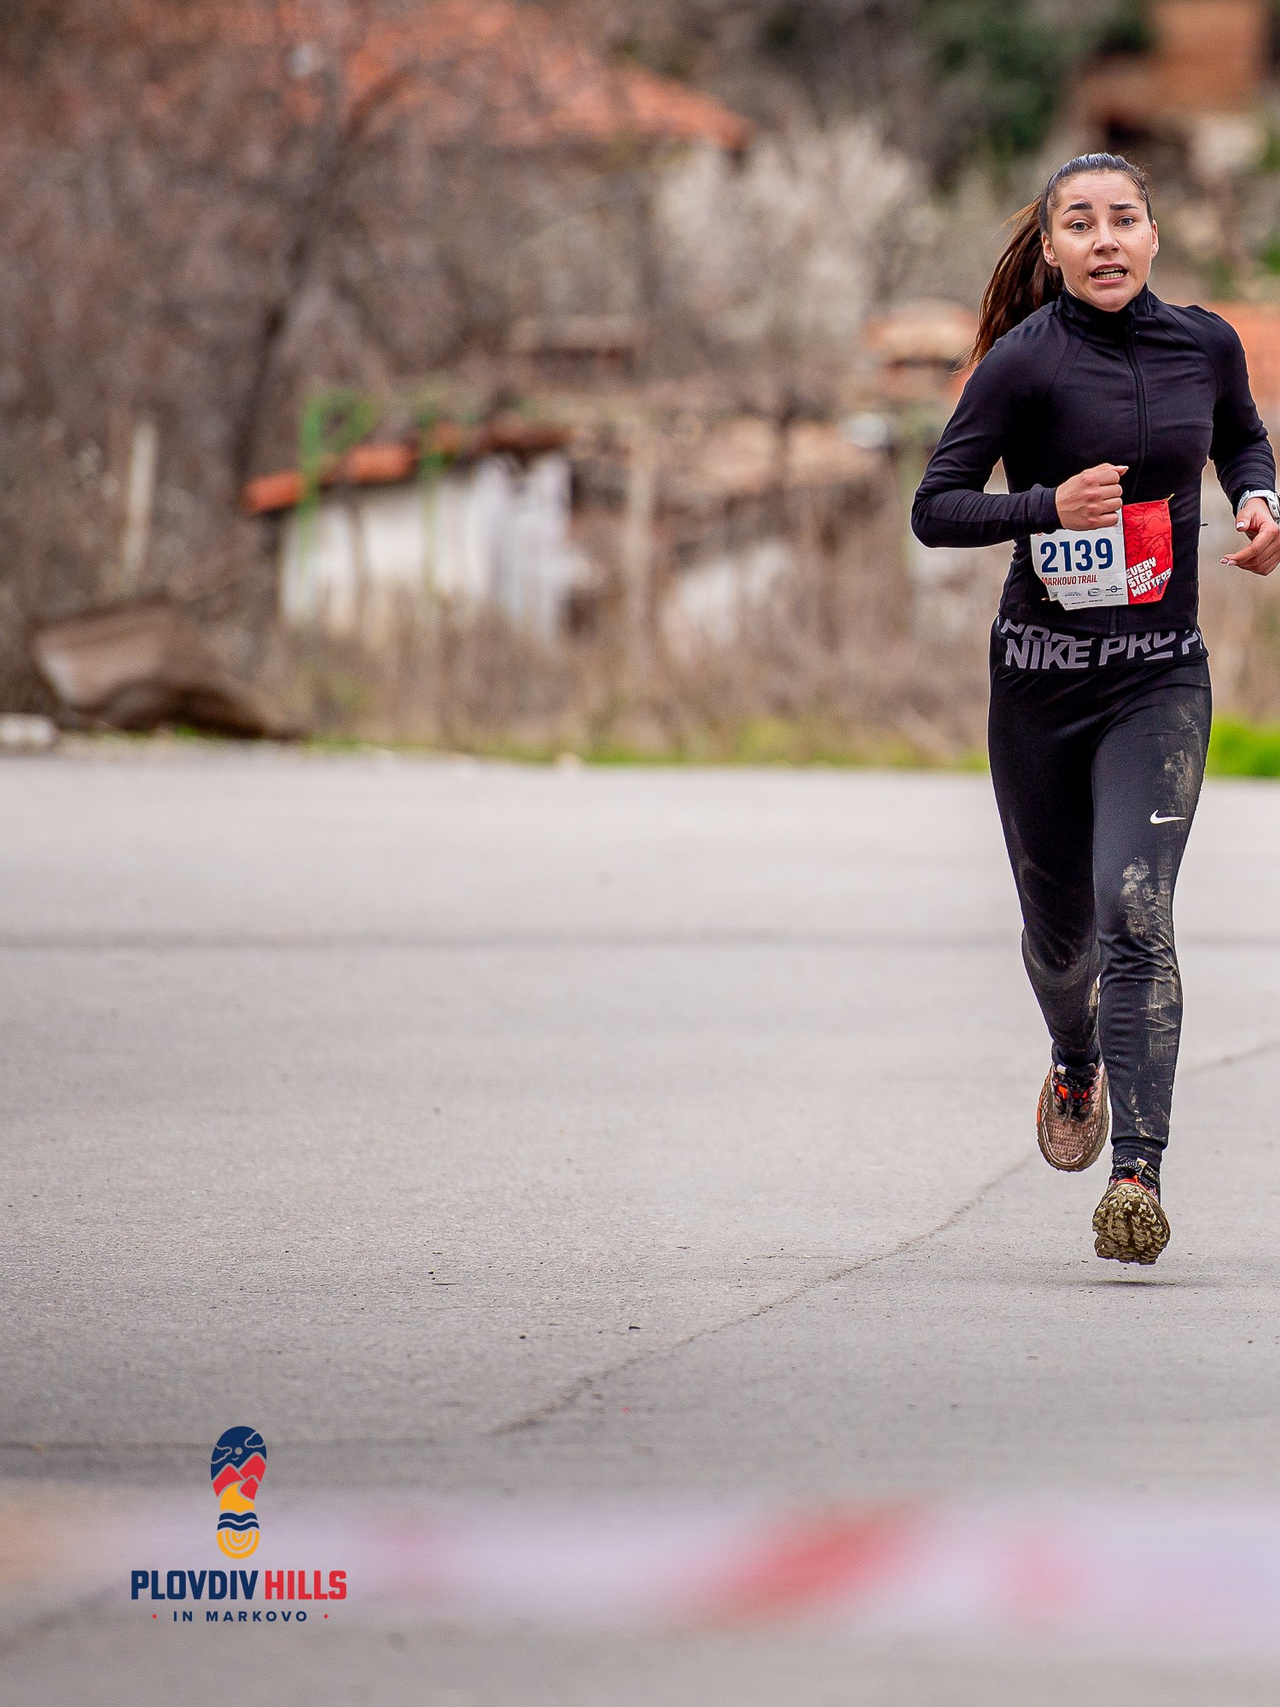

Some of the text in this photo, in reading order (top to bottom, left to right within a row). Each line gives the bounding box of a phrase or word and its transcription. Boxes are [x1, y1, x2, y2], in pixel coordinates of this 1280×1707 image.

[1040, 538, 1114, 574] 2139
[1126, 556, 1157, 578] EVERY
[1041, 573, 1098, 586] MARKOVO TRAIL
[1127, 569, 1153, 588] STEP
[1131, 567, 1172, 597] MATTERS
[1005, 638, 1093, 670] NIKE
